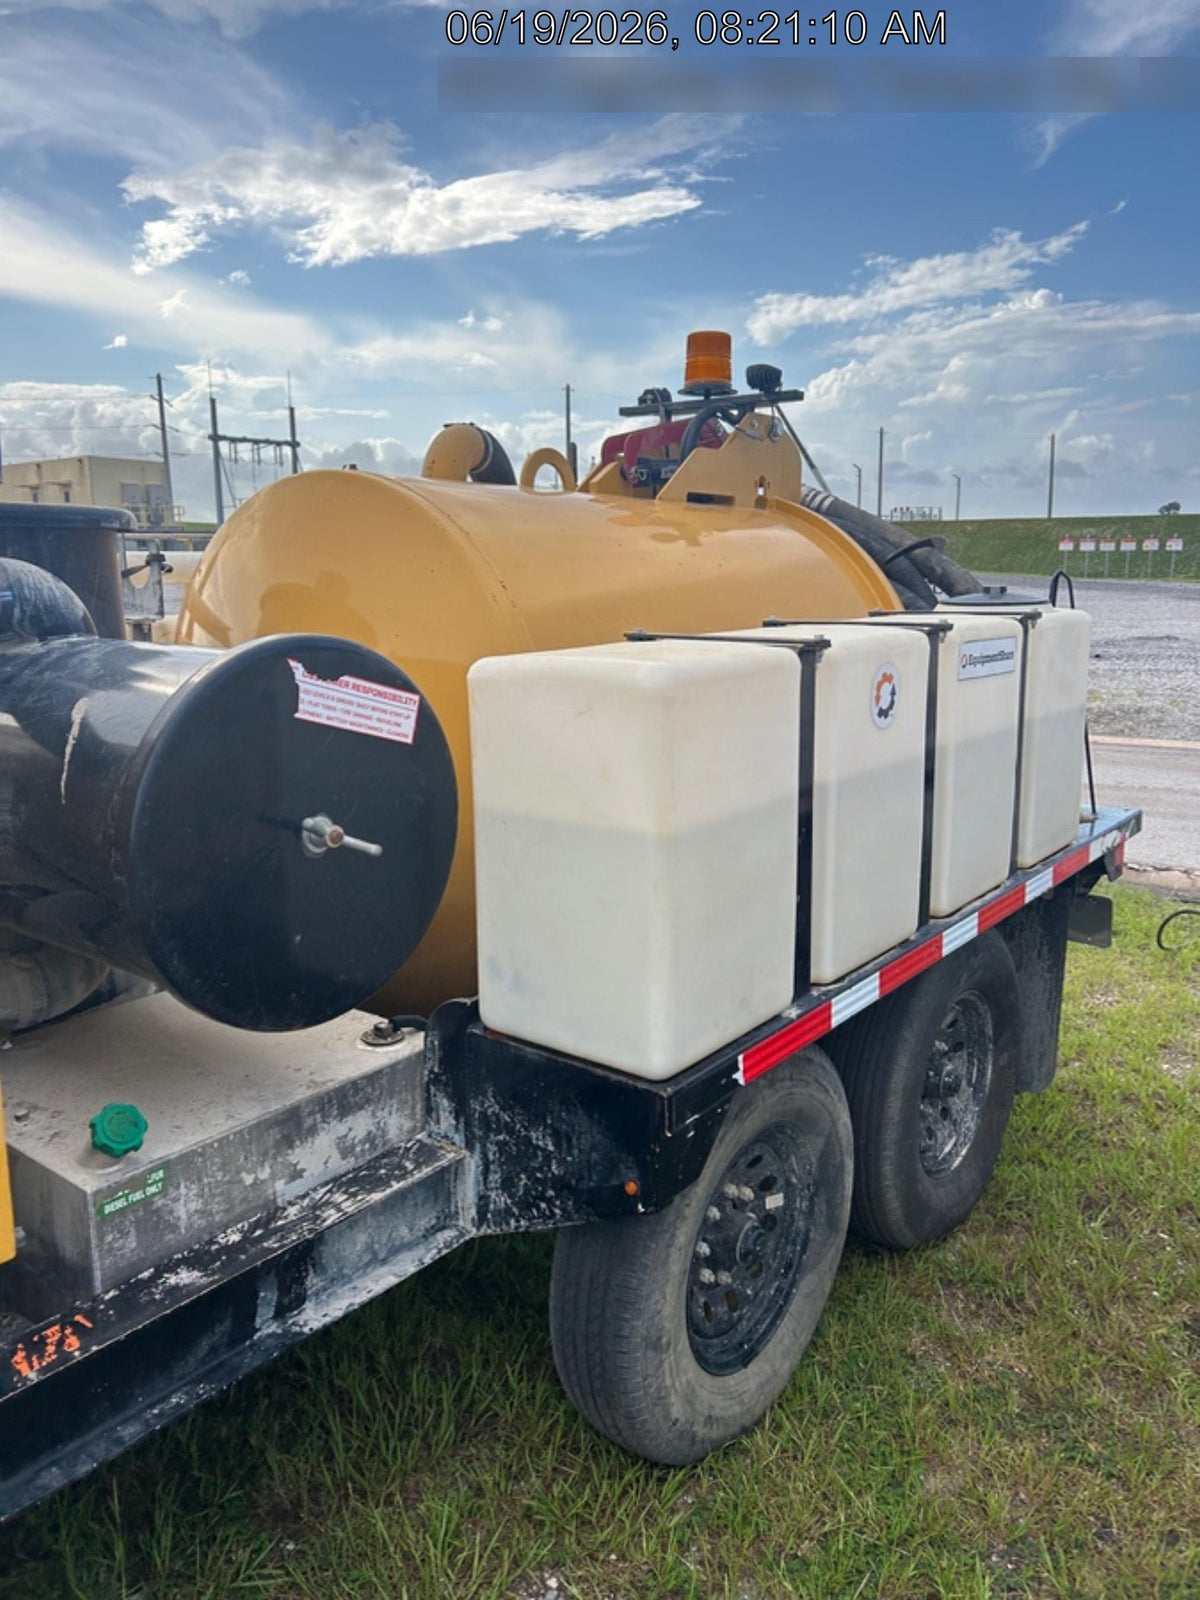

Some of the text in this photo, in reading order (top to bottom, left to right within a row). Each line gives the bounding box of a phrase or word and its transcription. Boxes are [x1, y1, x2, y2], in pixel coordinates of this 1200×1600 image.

[352, 682, 417, 705] RESPONSIBILITY
[104, 1197, 128, 1214] DIESEL
[128, 1189, 145, 1204] FUEL
[145, 1182, 162, 1196] ONLY
